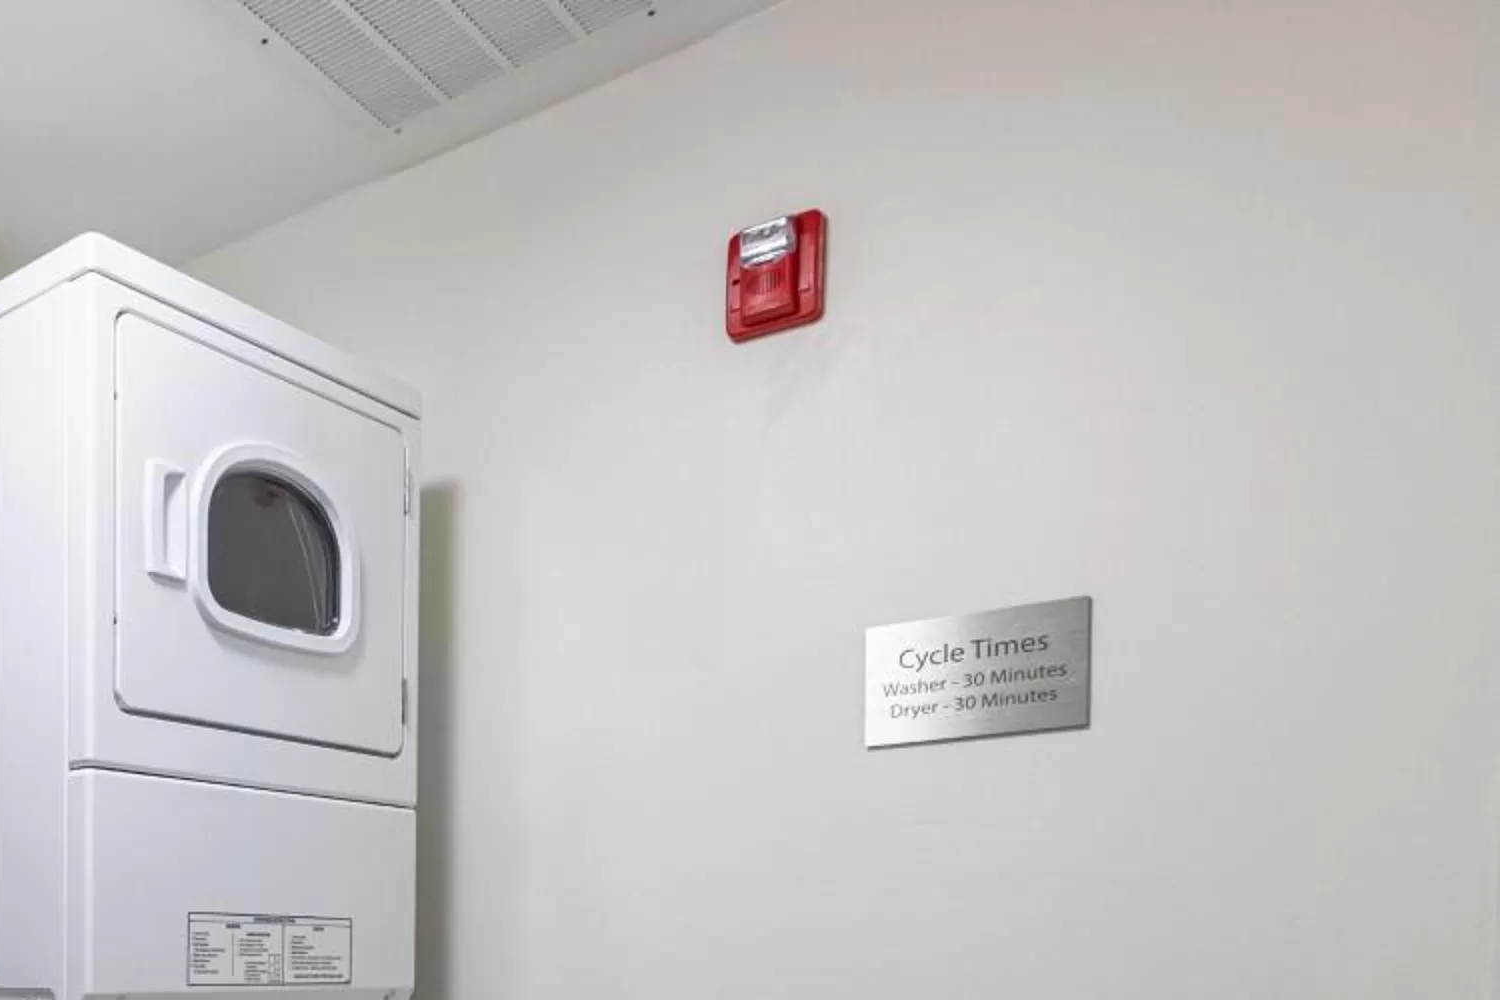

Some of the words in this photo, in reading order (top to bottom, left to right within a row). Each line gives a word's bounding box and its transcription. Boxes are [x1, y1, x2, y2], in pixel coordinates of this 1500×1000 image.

[899, 643, 965, 673] Cycle
[970, 635, 1049, 659] Times
[882, 679, 947, 697] Washer
[963, 672, 985, 688] 30
[990, 664, 1068, 685] Minutes
[890, 703, 939, 719] Dryer
[955, 694, 977, 711] 30
[981, 689, 1058, 709] Minutes
